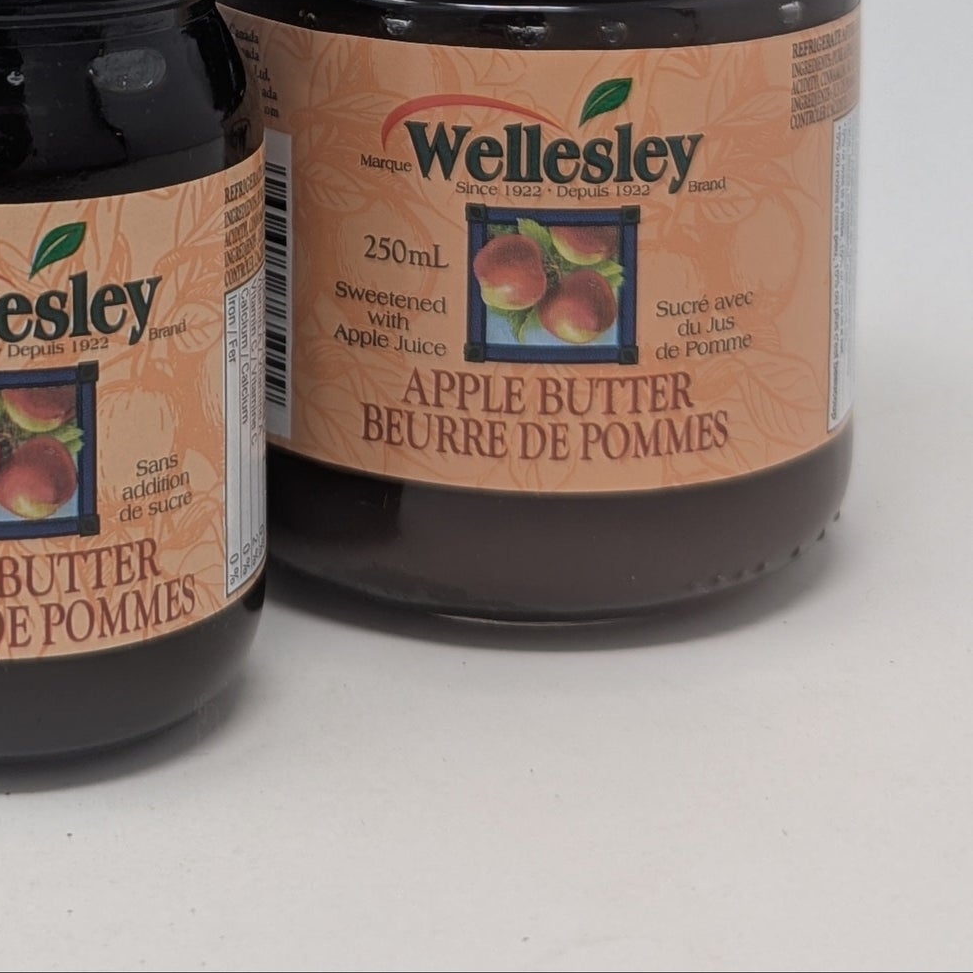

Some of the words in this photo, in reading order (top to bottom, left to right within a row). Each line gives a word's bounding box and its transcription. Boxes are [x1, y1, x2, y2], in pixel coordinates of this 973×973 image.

[360, 153, 412, 174] Marque
[404, 120, 704, 195] Wellesley
[687, 176, 726, 194] Brand
[455, 181, 498, 196] Since
[504, 184, 542, 197] 1922
[556, 184, 609, 200] Depuis
[615, 183, 650, 197] 1922
[363, 234, 450, 270] 250mL
[228, 294, 238, 326] Iron
[249, 278, 257, 336] Vitamin
[334, 280, 446, 315] Sweetened
[655, 293, 710, 318] Sucré
[715, 289, 754, 310] avec
[148, 319, 188, 342] Brand
[240, 287, 249, 350] Calcium
[367, 310, 410, 332] with
[677, 316, 702, 337] du
[706, 313, 735, 333] Jus
[7, 342, 65, 359] Depuis
[71, 337, 109, 353] 1922
[228, 338, 238, 363] Fer
[250, 338, 257, 352] C
[334, 324, 389, 352] Apple
[393, 334, 447, 357] Juice
[655, 339, 680, 361] de
[685, 332, 753, 357] Pomme
[241, 361, 250, 425] Calcium
[250, 365, 258, 430] Vitamine
[401, 367, 525, 415] APPLE
[537, 371, 695, 416] BUTTER
[251, 432, 258, 446] C
[360, 401, 508, 458] BEURRE
[519, 423, 570, 461] DE
[581, 410, 729, 462] POMMES
[136, 453, 179, 478] Sans
[122, 470, 190, 502] addition
[119, 501, 143, 523] de
[147, 490, 193, 517] sucre
[229, 552, 239, 565] 0
[42, 572, 197, 646] POMMES
